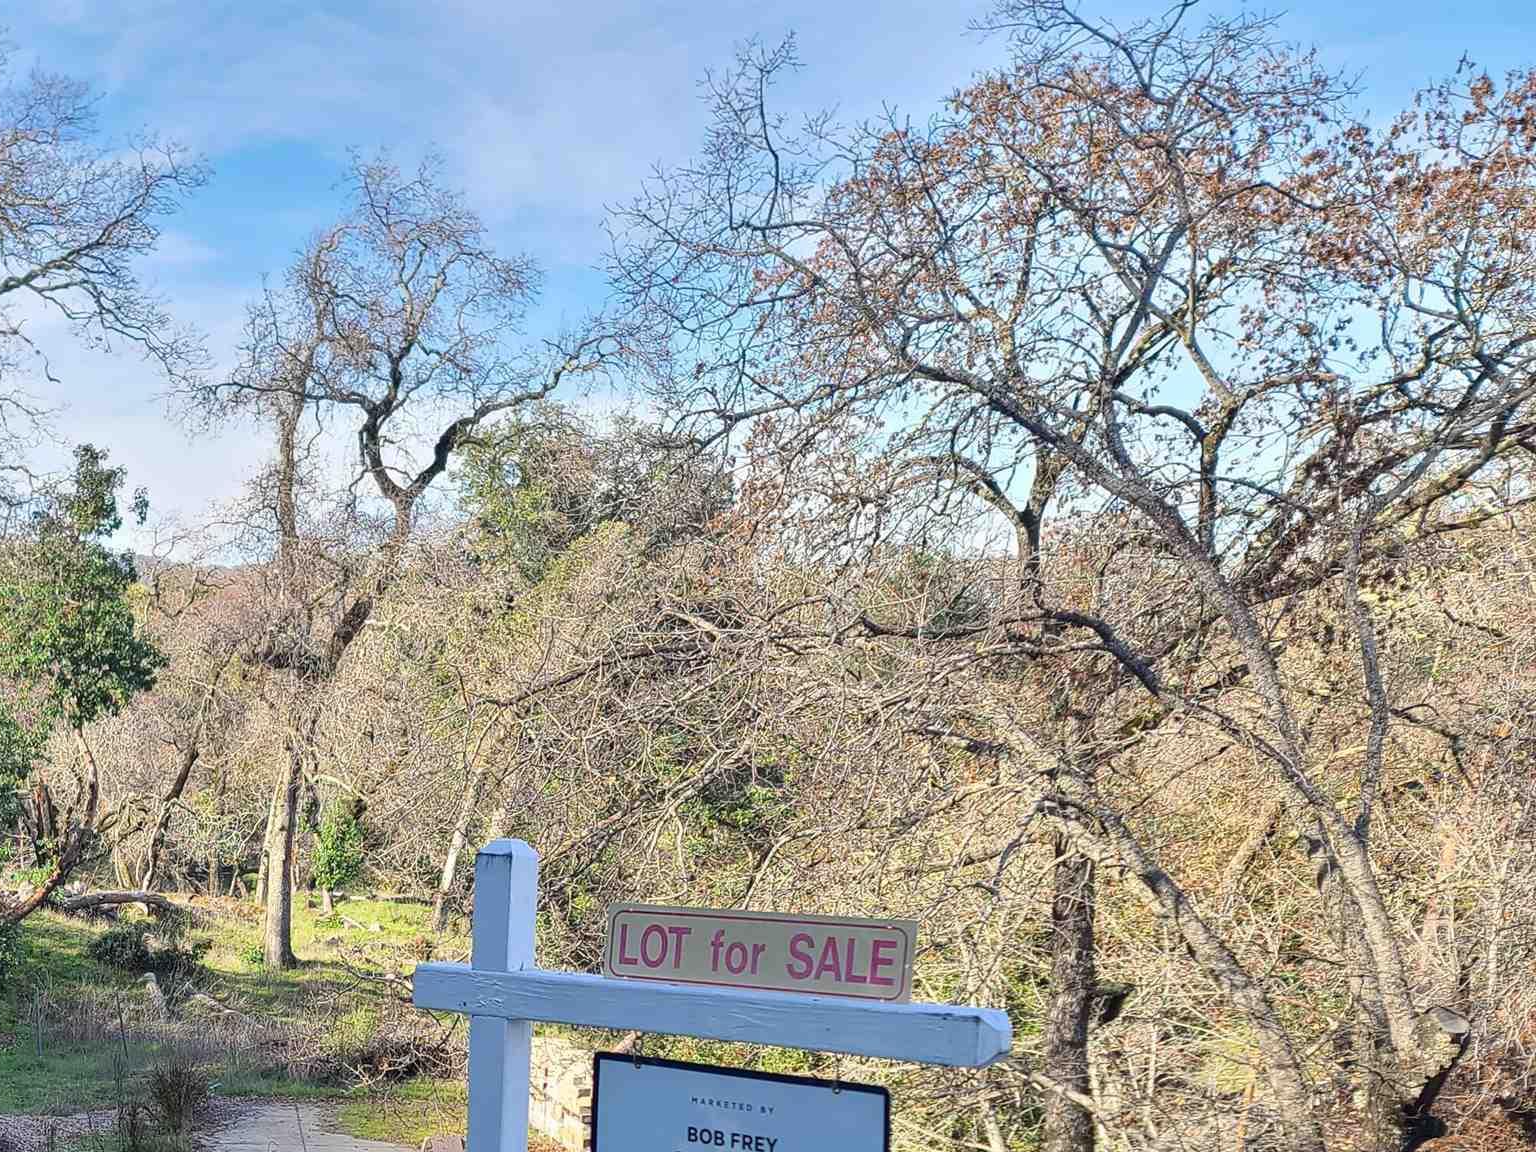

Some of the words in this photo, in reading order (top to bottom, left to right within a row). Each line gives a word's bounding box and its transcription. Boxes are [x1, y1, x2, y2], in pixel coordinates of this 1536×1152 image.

[619, 924, 692, 969] LOT
[710, 929, 766, 975] for
[786, 933, 897, 986] SALE
[691, 1096, 753, 1112] MARKETED
[760, 1106, 775, 1115] BY
[687, 1126, 725, 1146] BOB
